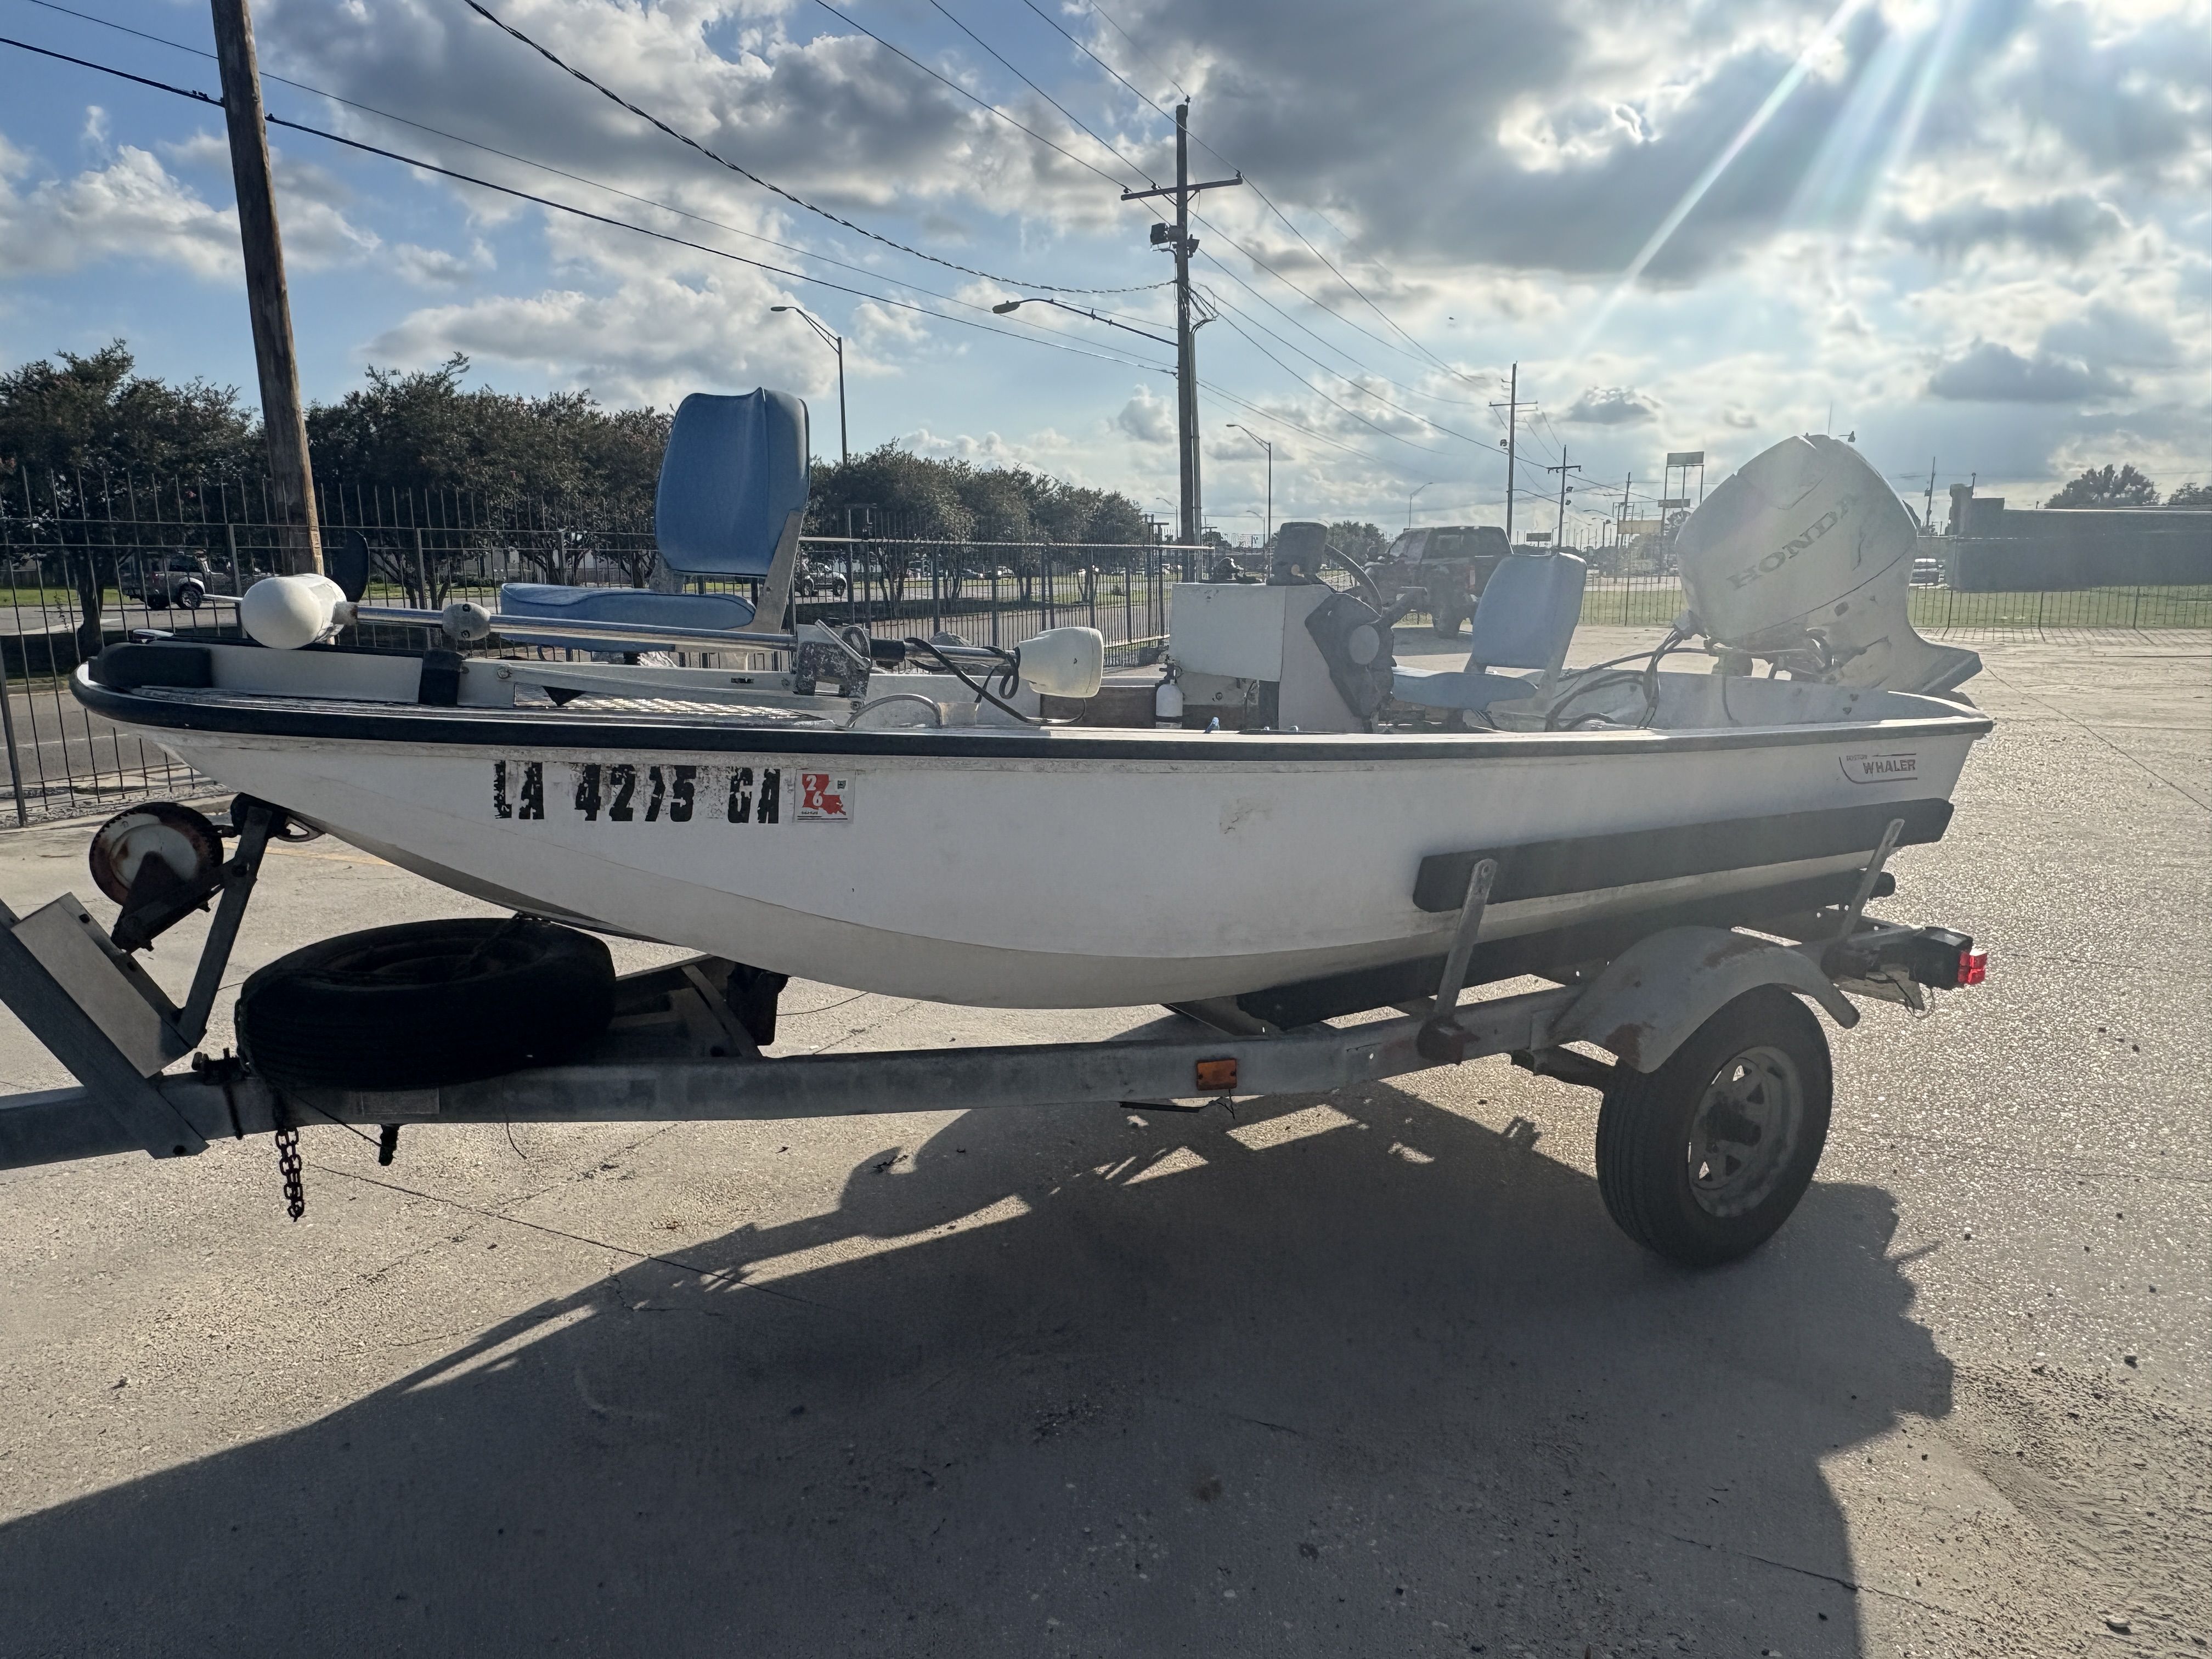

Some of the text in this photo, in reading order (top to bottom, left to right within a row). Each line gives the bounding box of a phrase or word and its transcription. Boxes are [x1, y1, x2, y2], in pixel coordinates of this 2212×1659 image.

[1863, 759, 1916, 774] WHALER
[494, 760, 544, 820] LA
[575, 763, 696, 822] 4275
